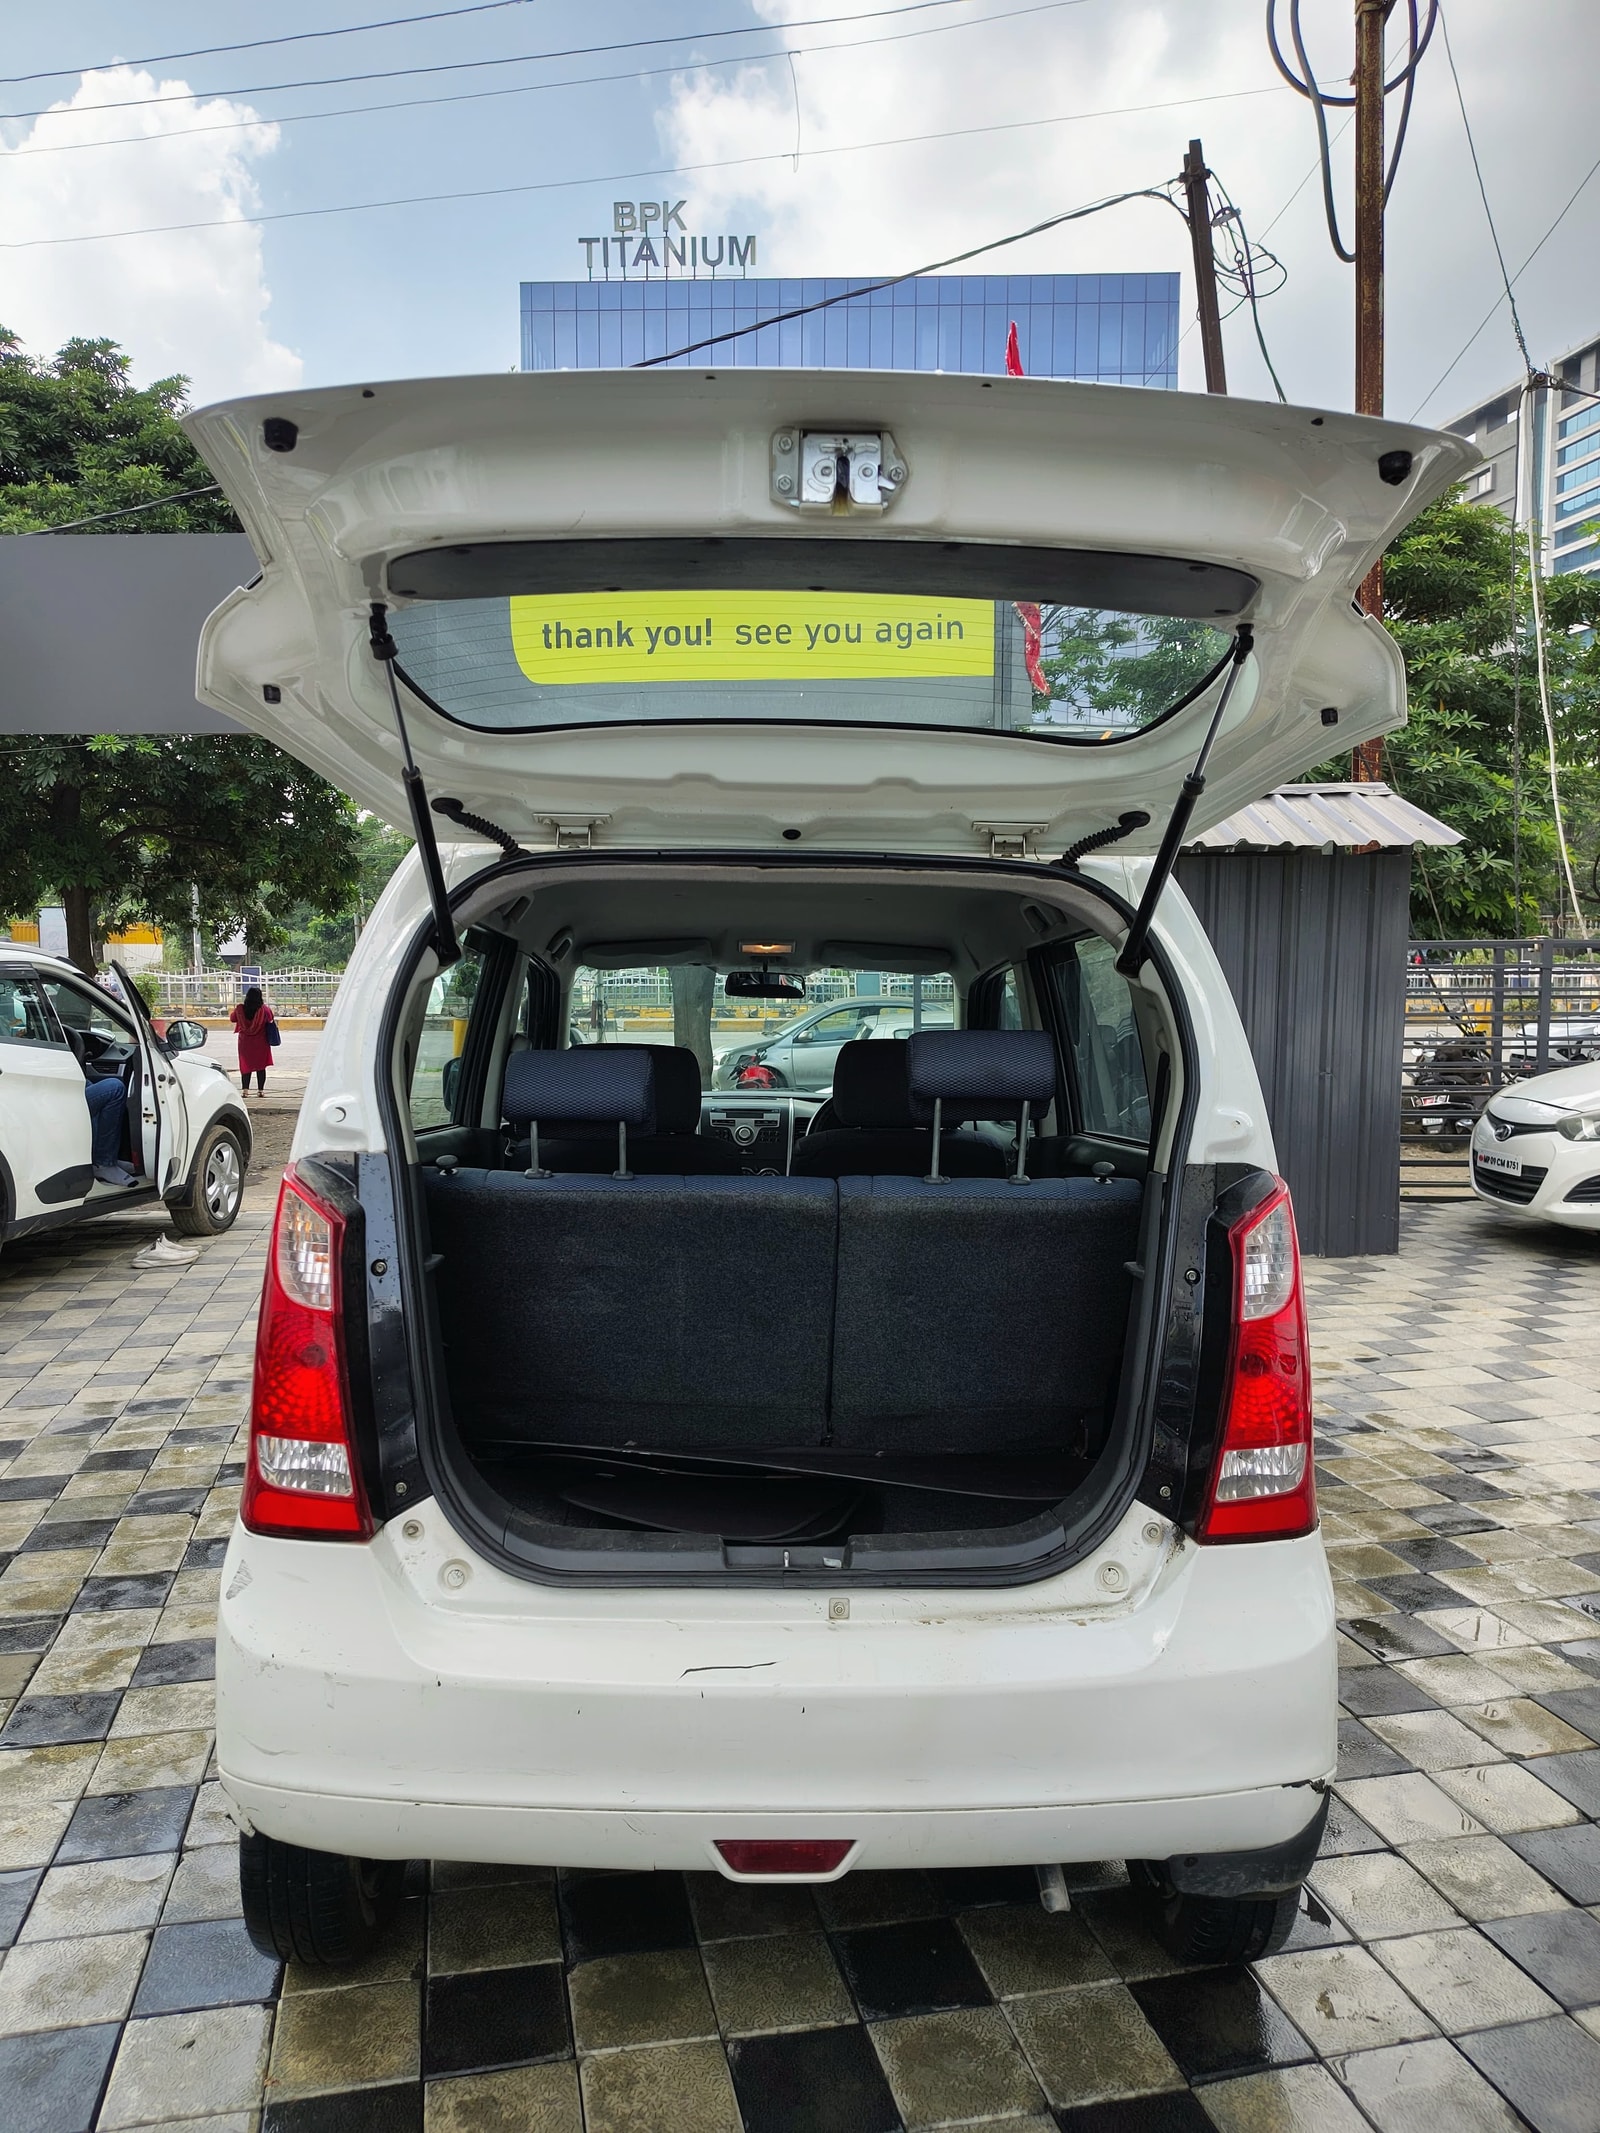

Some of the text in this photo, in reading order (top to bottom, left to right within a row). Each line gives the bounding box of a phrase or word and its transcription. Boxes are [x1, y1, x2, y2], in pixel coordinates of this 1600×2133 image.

[613, 200, 687, 232] BPK
[578, 235, 756, 268] TITANIUM
[541, 613, 965, 655] thank you! see you again
